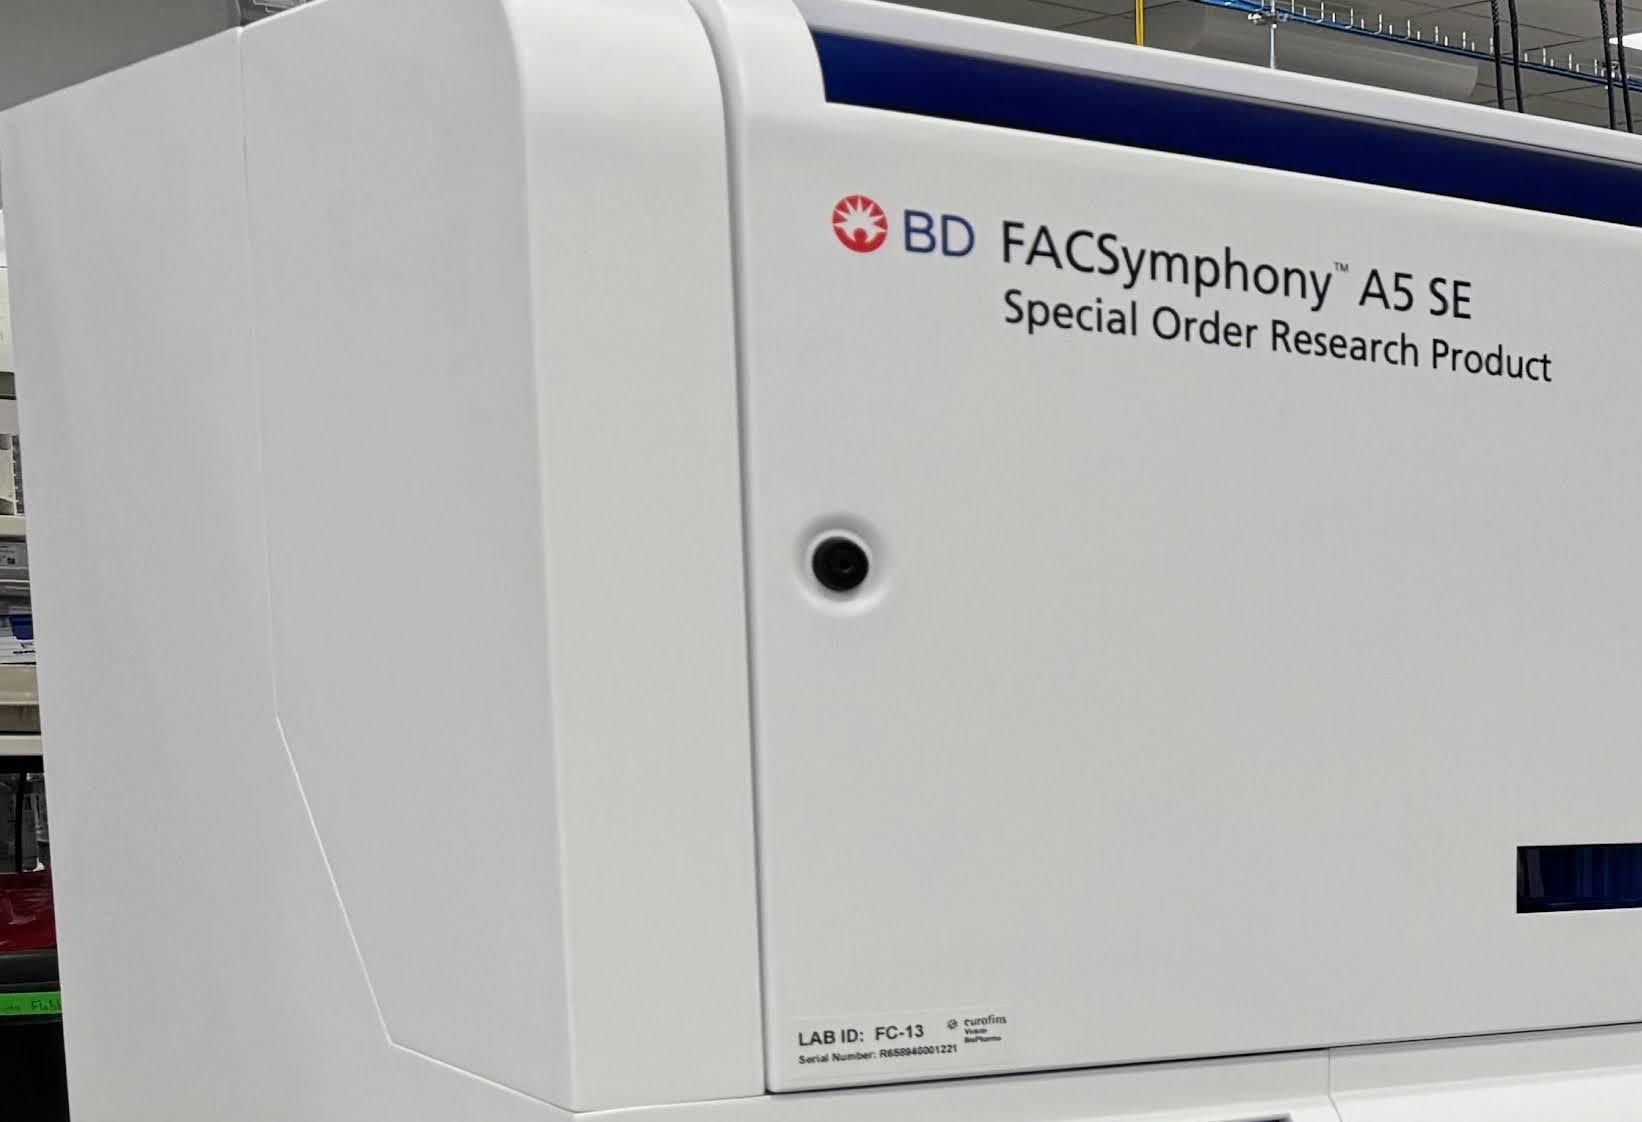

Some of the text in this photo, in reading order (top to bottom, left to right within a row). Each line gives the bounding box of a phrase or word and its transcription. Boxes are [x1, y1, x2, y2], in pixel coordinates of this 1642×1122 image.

[904, 209, 975, 257] BD
[1358, 267, 1415, 313] A5
[1429, 276, 1472, 320] SE
[1004, 288, 1554, 383] Special Order Research Product
[964, 1014, 1008, 1027] eurofins
[798, 1024, 925, 1047] LAB ID: FC-13
[799, 1053, 830, 1065] Serial
[832, 1050, 877, 1063] Number:
